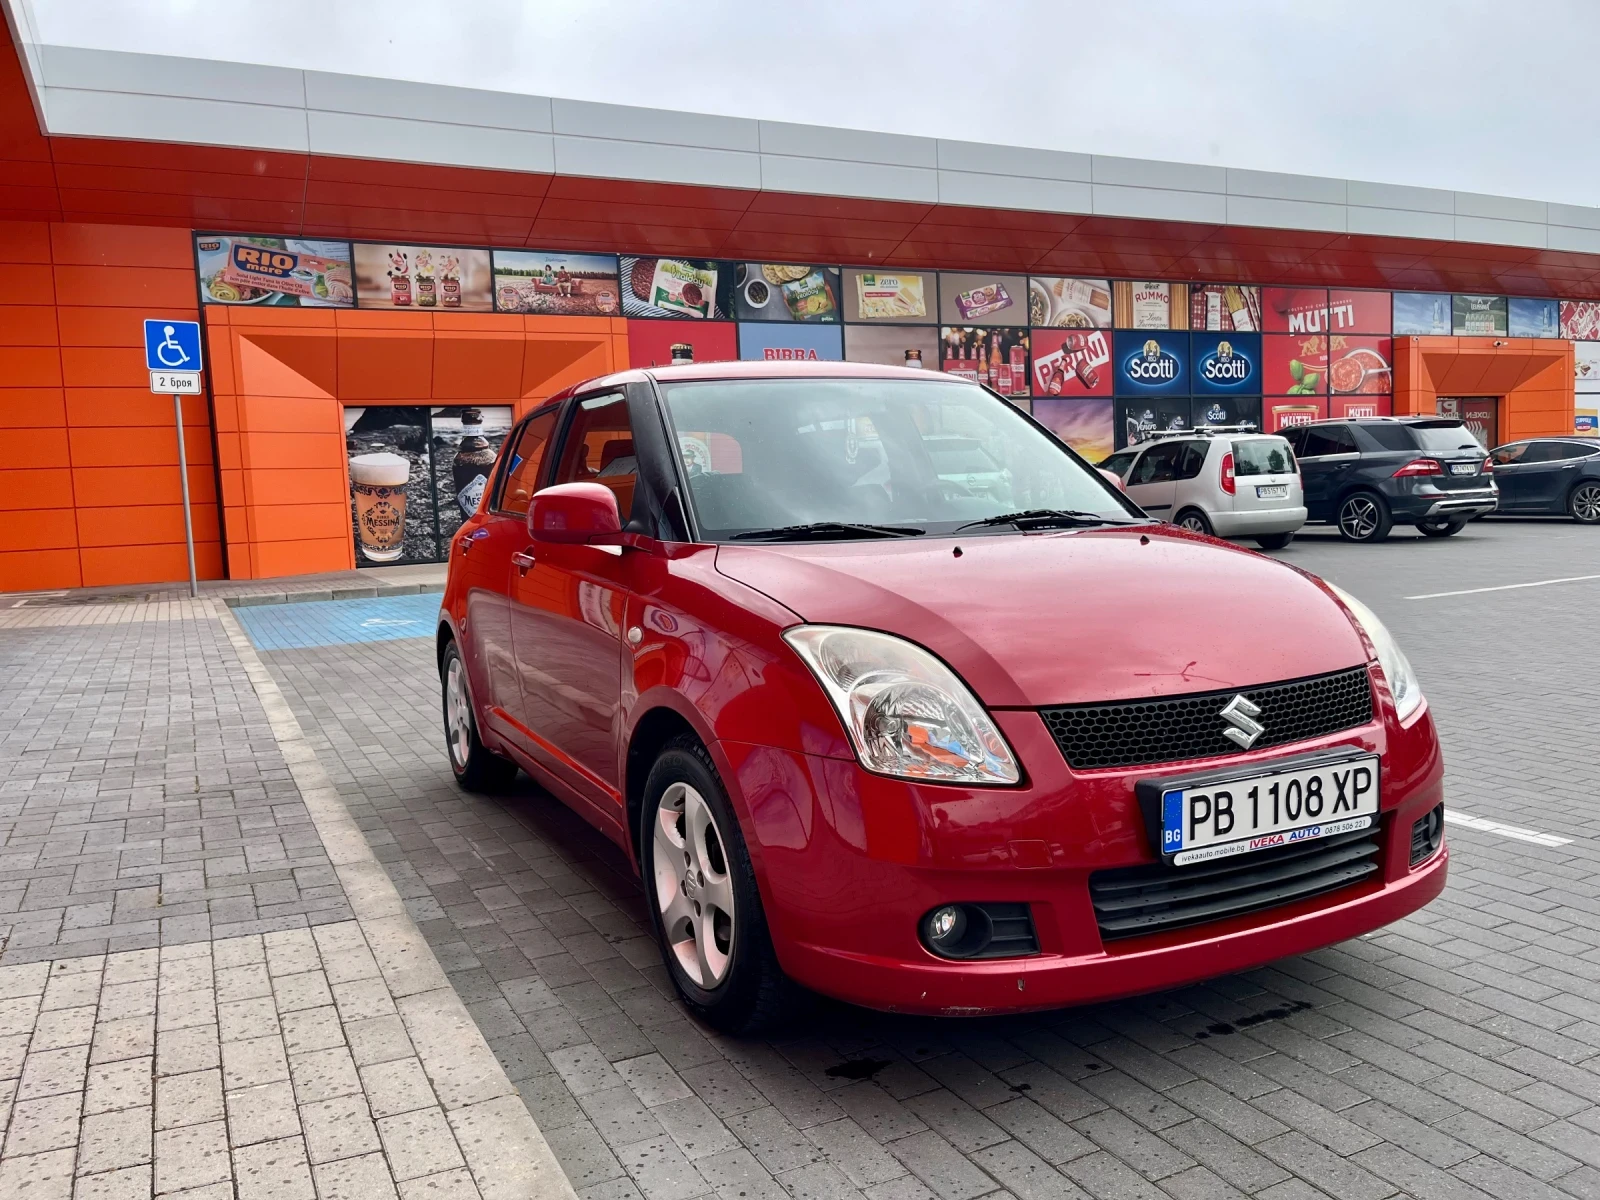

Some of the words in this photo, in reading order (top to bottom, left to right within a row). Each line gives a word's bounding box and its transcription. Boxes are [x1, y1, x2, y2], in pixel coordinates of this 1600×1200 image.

[237, 248, 294, 270] RIO
[246, 263, 283, 276] mare
[1135, 291, 1169, 304] RUMMO
[1288, 304, 1355, 337] MUTTI
[763, 348, 818, 360] BIRRA
[1130, 358, 1173, 379] Scotti
[1205, 359, 1245, 379] Scotti
[159, 377, 166, 387] 2
[170, 377, 192, 389] броя
[1207, 411, 1226, 420] Scotti
[1349, 408, 1373, 417] MUTTI
[1280, 416, 1312, 428] MUTTI
[365, 515, 400, 527] MESSINA
[1189, 790, 1235, 841] PB
[1247, 775, 1324, 829] 1108
[1332, 766, 1372, 814] XP
[1165, 829, 1181, 844] BG
[1181, 844, 1245, 862] ivekaauto.mobile.bg
[1249, 834, 1285, 849] IVEKA
[1289, 826, 1321, 841] AUTO
[1325, 824, 1340, 834] 0878
[1342, 823, 1353, 831] 506
[1354, 819, 1366, 828] 221
